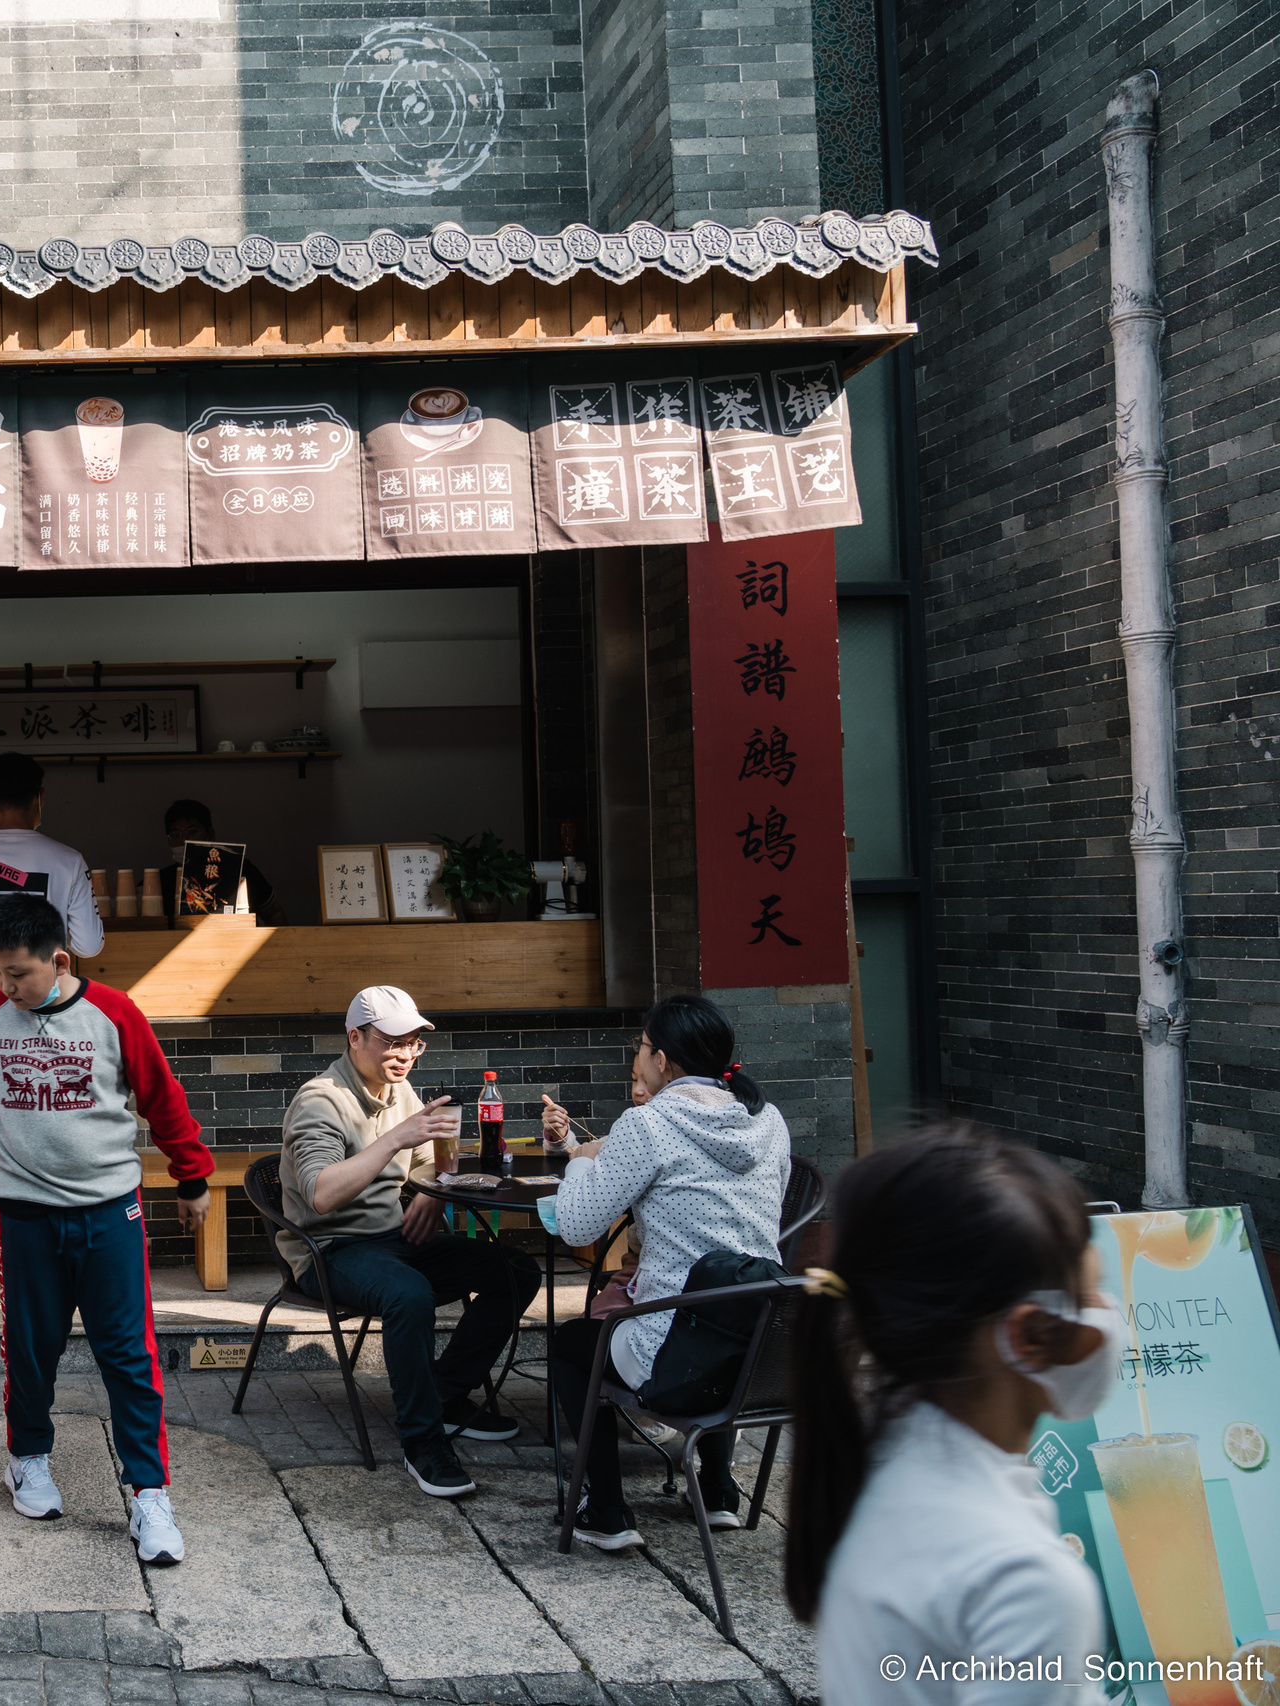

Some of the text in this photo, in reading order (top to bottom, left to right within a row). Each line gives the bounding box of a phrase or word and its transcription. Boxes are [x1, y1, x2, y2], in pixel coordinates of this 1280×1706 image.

[568, 381, 836, 441] 手作 茶铺
[218, 416, 320, 438] 港式风味
[219, 441, 321, 463] 招牌奶茶
[380, 467, 511, 496] 选料讲究
[568, 448, 842, 512] 撞茶 工艺
[227, 490, 311, 510] 全日供应
[39, 494, 53, 556] 满口留香
[67, 493, 81, 554] 奶香悠久
[95, 492, 110, 553] 茶味浓郁
[124, 491, 139, 553] 经典传承
[153, 492, 167, 553] 正宗港味
[383, 504, 512, 531] 回味甘甜
[0, 1037, 96, 1052] LEVI STRAUSS & CO.
[2, 1056, 91, 1069] ORIGINAL RIVETED
[11, 1067, 32, 1076] QUALITY
[1176, 1297, 1233, 1327] TEA
[218, 1348, 246, 1356] 小心台阶
[1032, 1441, 1059, 1471] 新品
[1047, 1455, 1070, 1487] 上市
